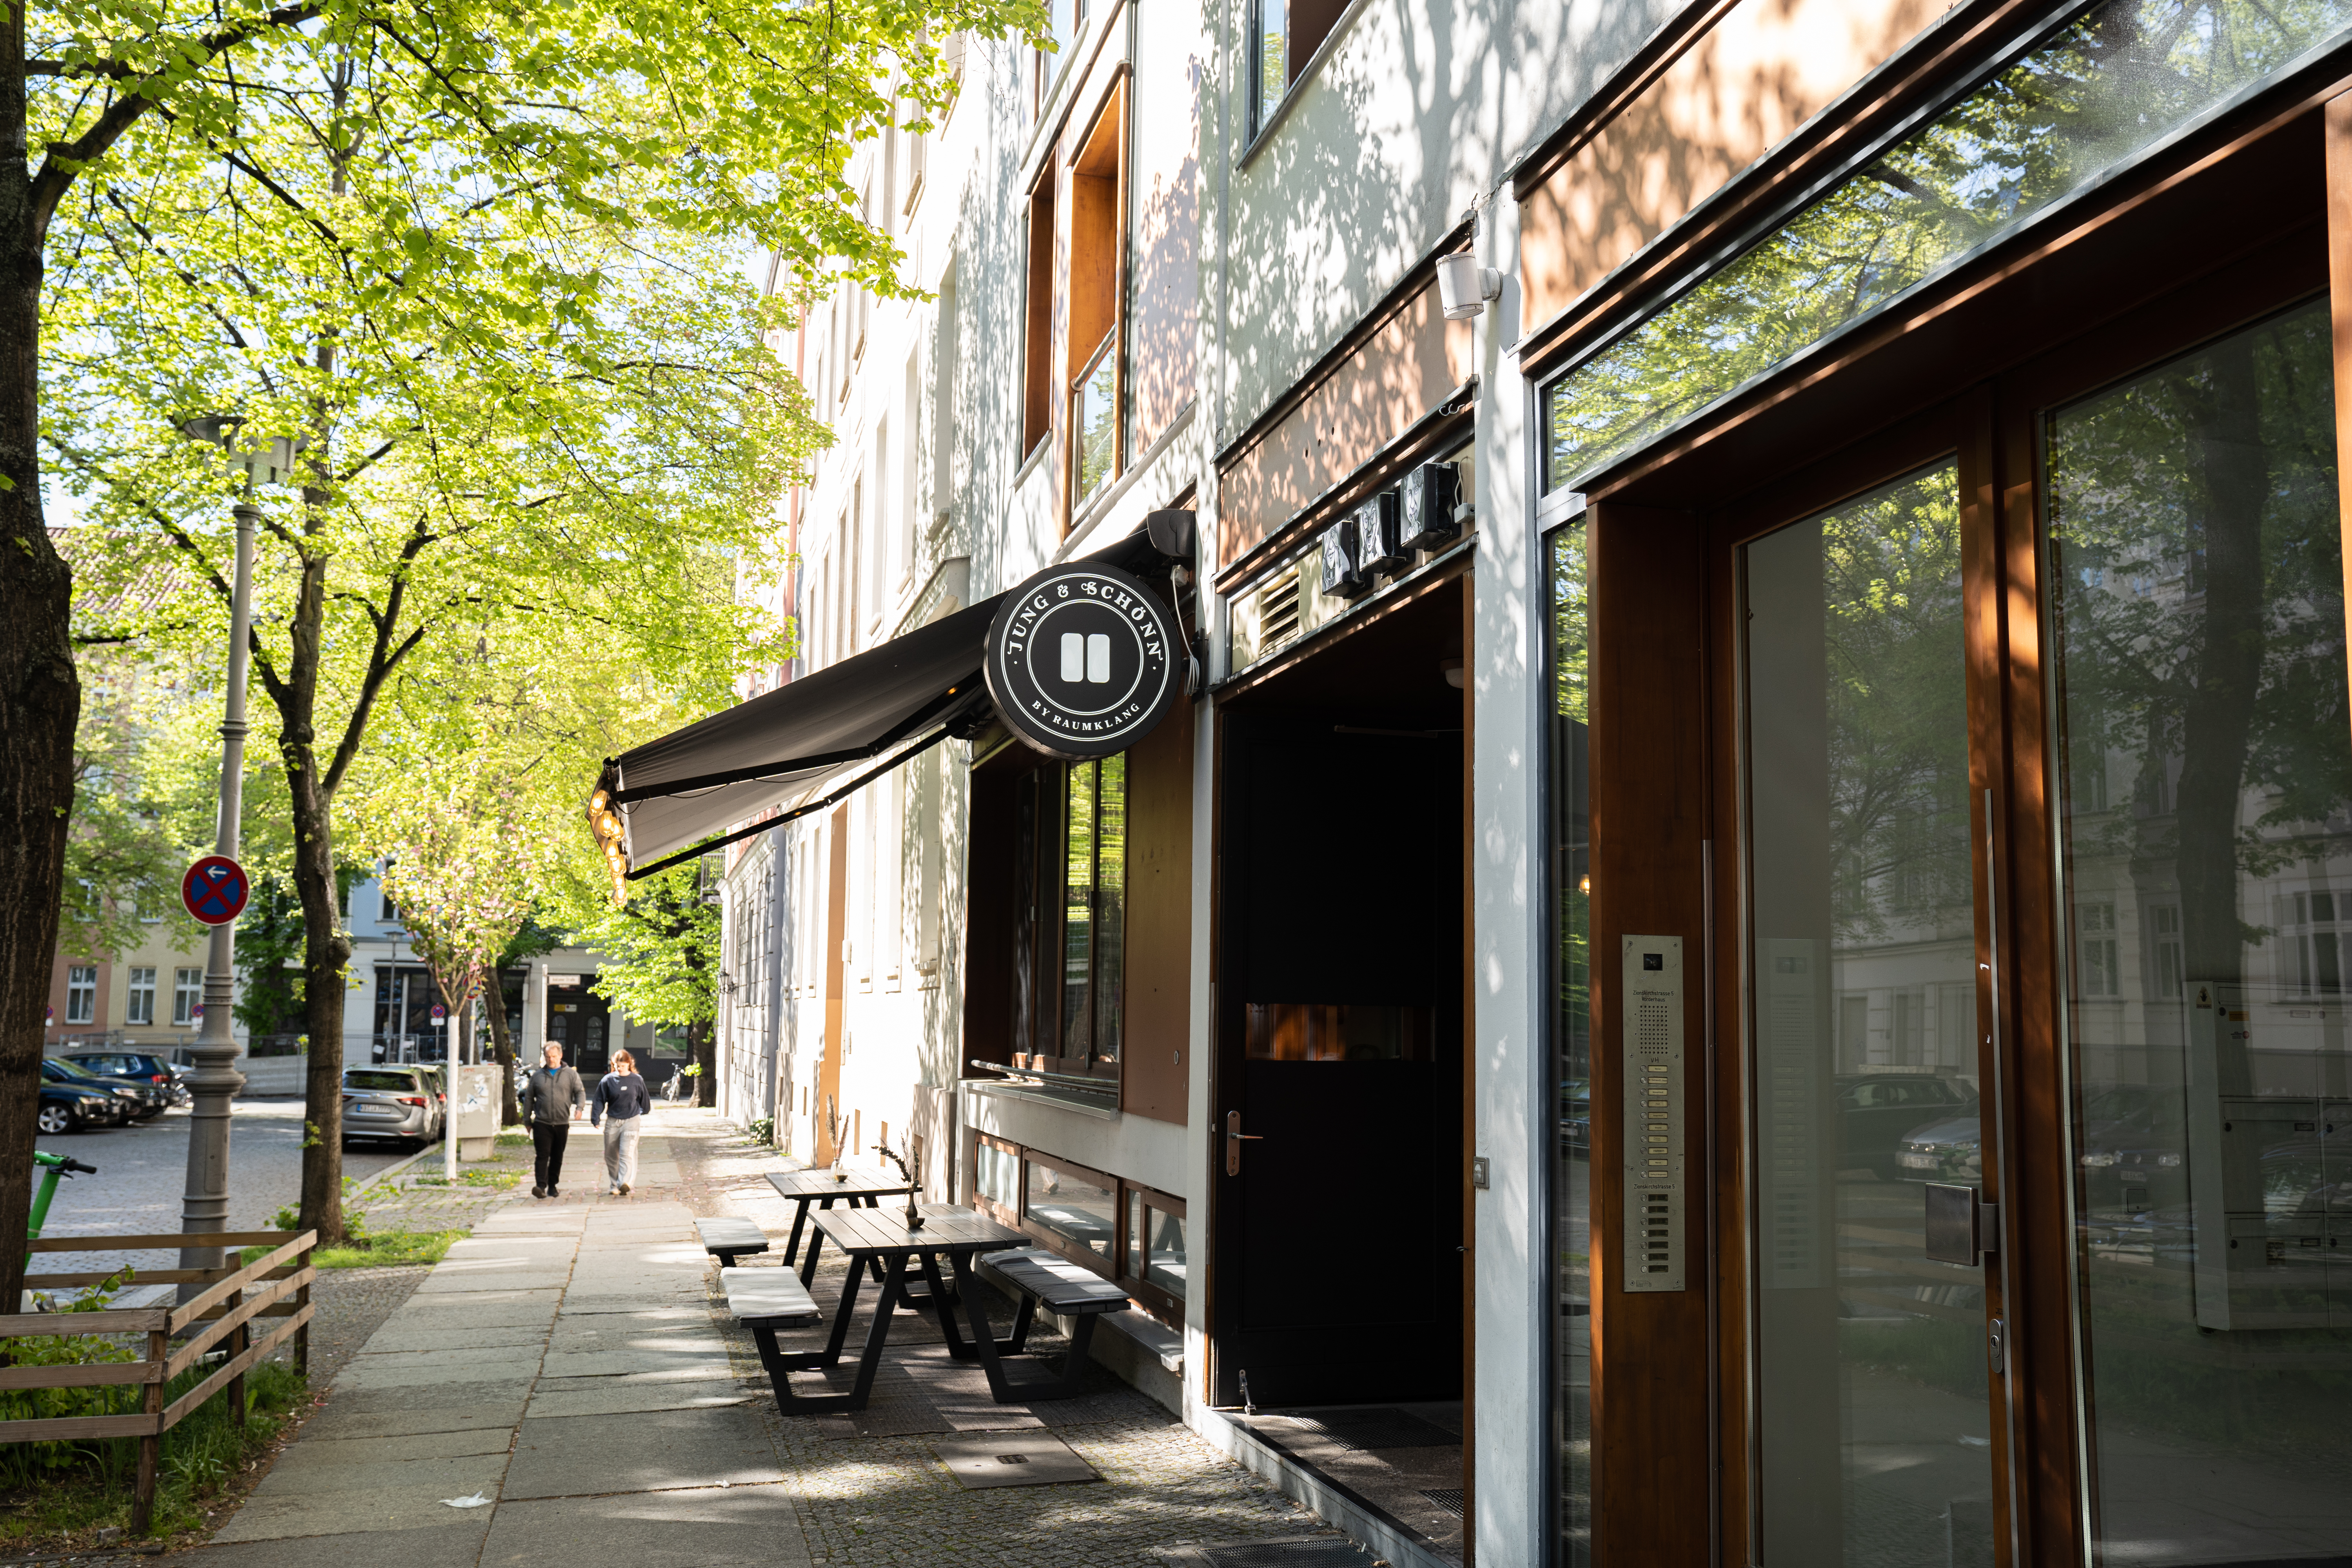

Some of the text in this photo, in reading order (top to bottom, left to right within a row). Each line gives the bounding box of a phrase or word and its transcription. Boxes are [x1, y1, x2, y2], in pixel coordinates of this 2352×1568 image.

[1007, 581, 1163, 661] JUNG & SCHÖNN
[1032, 700, 1140, 731] BY RAUMKLANG
